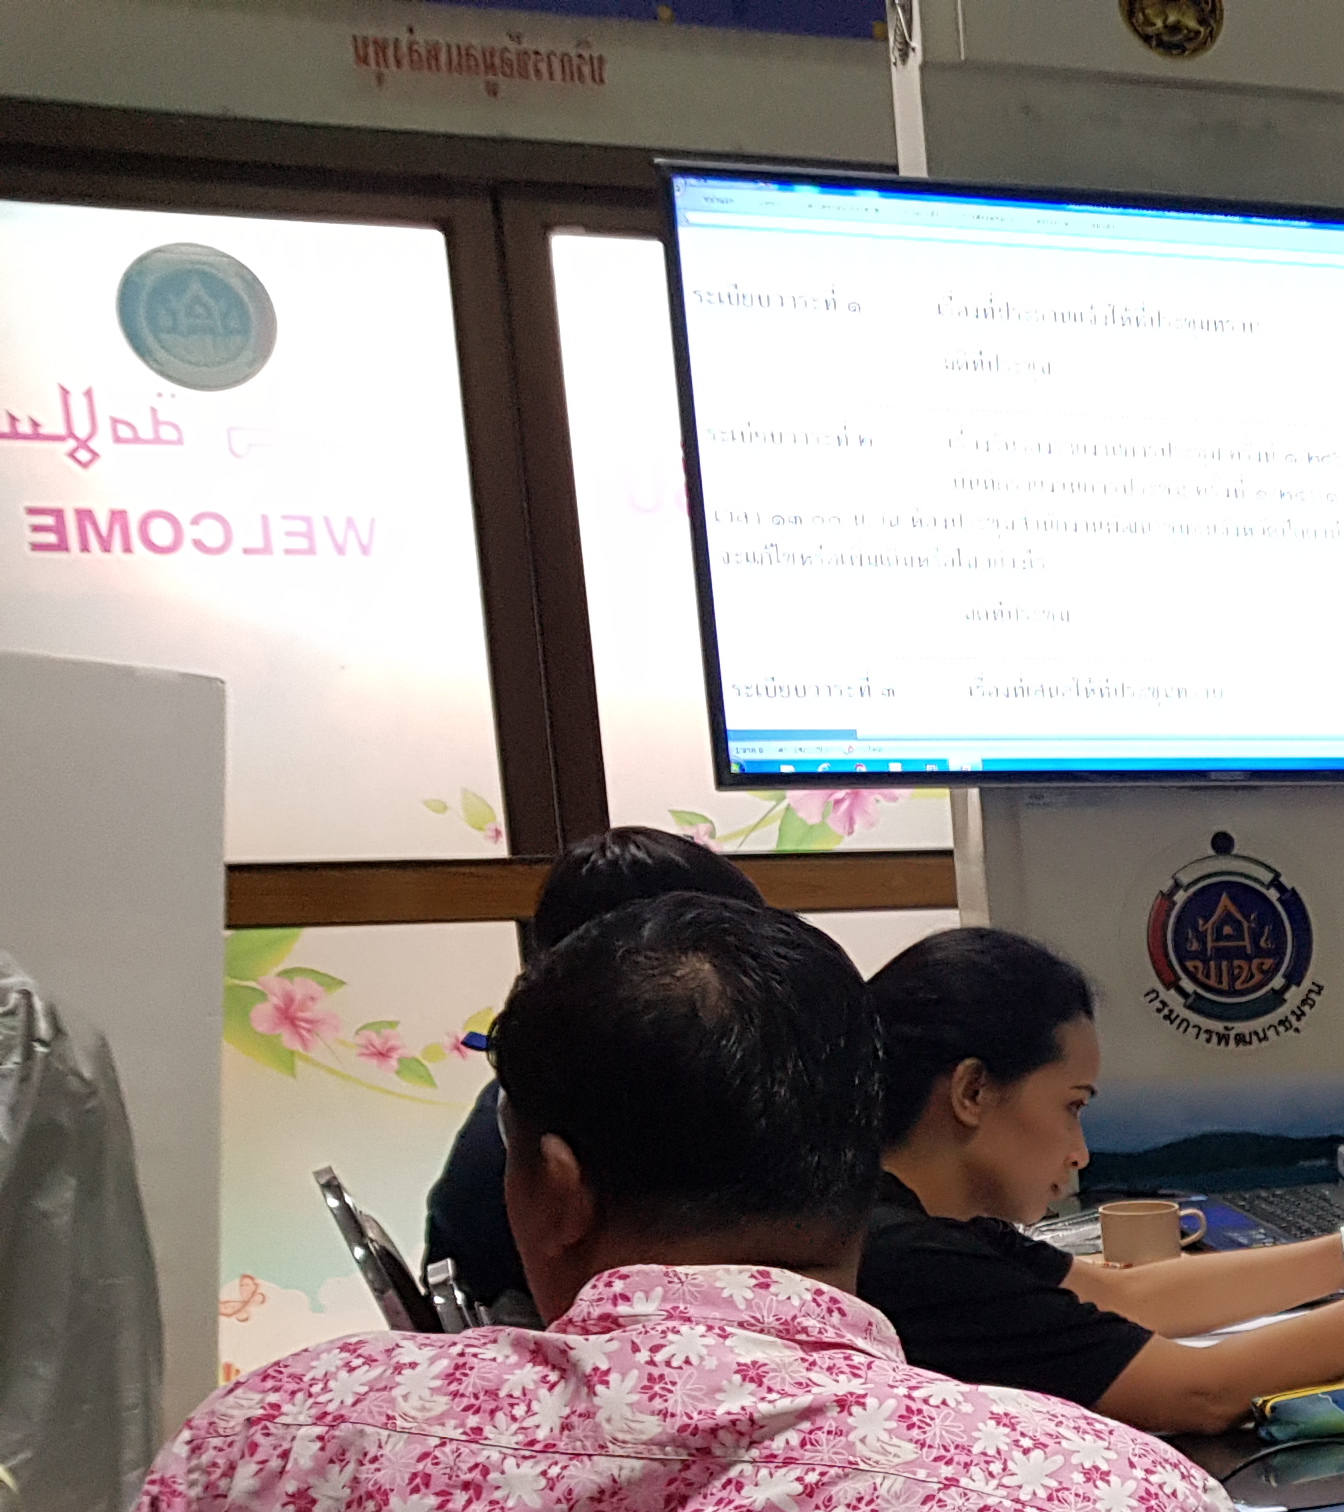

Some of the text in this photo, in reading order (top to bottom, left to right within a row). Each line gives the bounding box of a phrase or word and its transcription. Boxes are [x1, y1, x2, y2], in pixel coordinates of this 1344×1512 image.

[1142, 980, 1325, 1048] กรมการพัฒนาชุมชน
